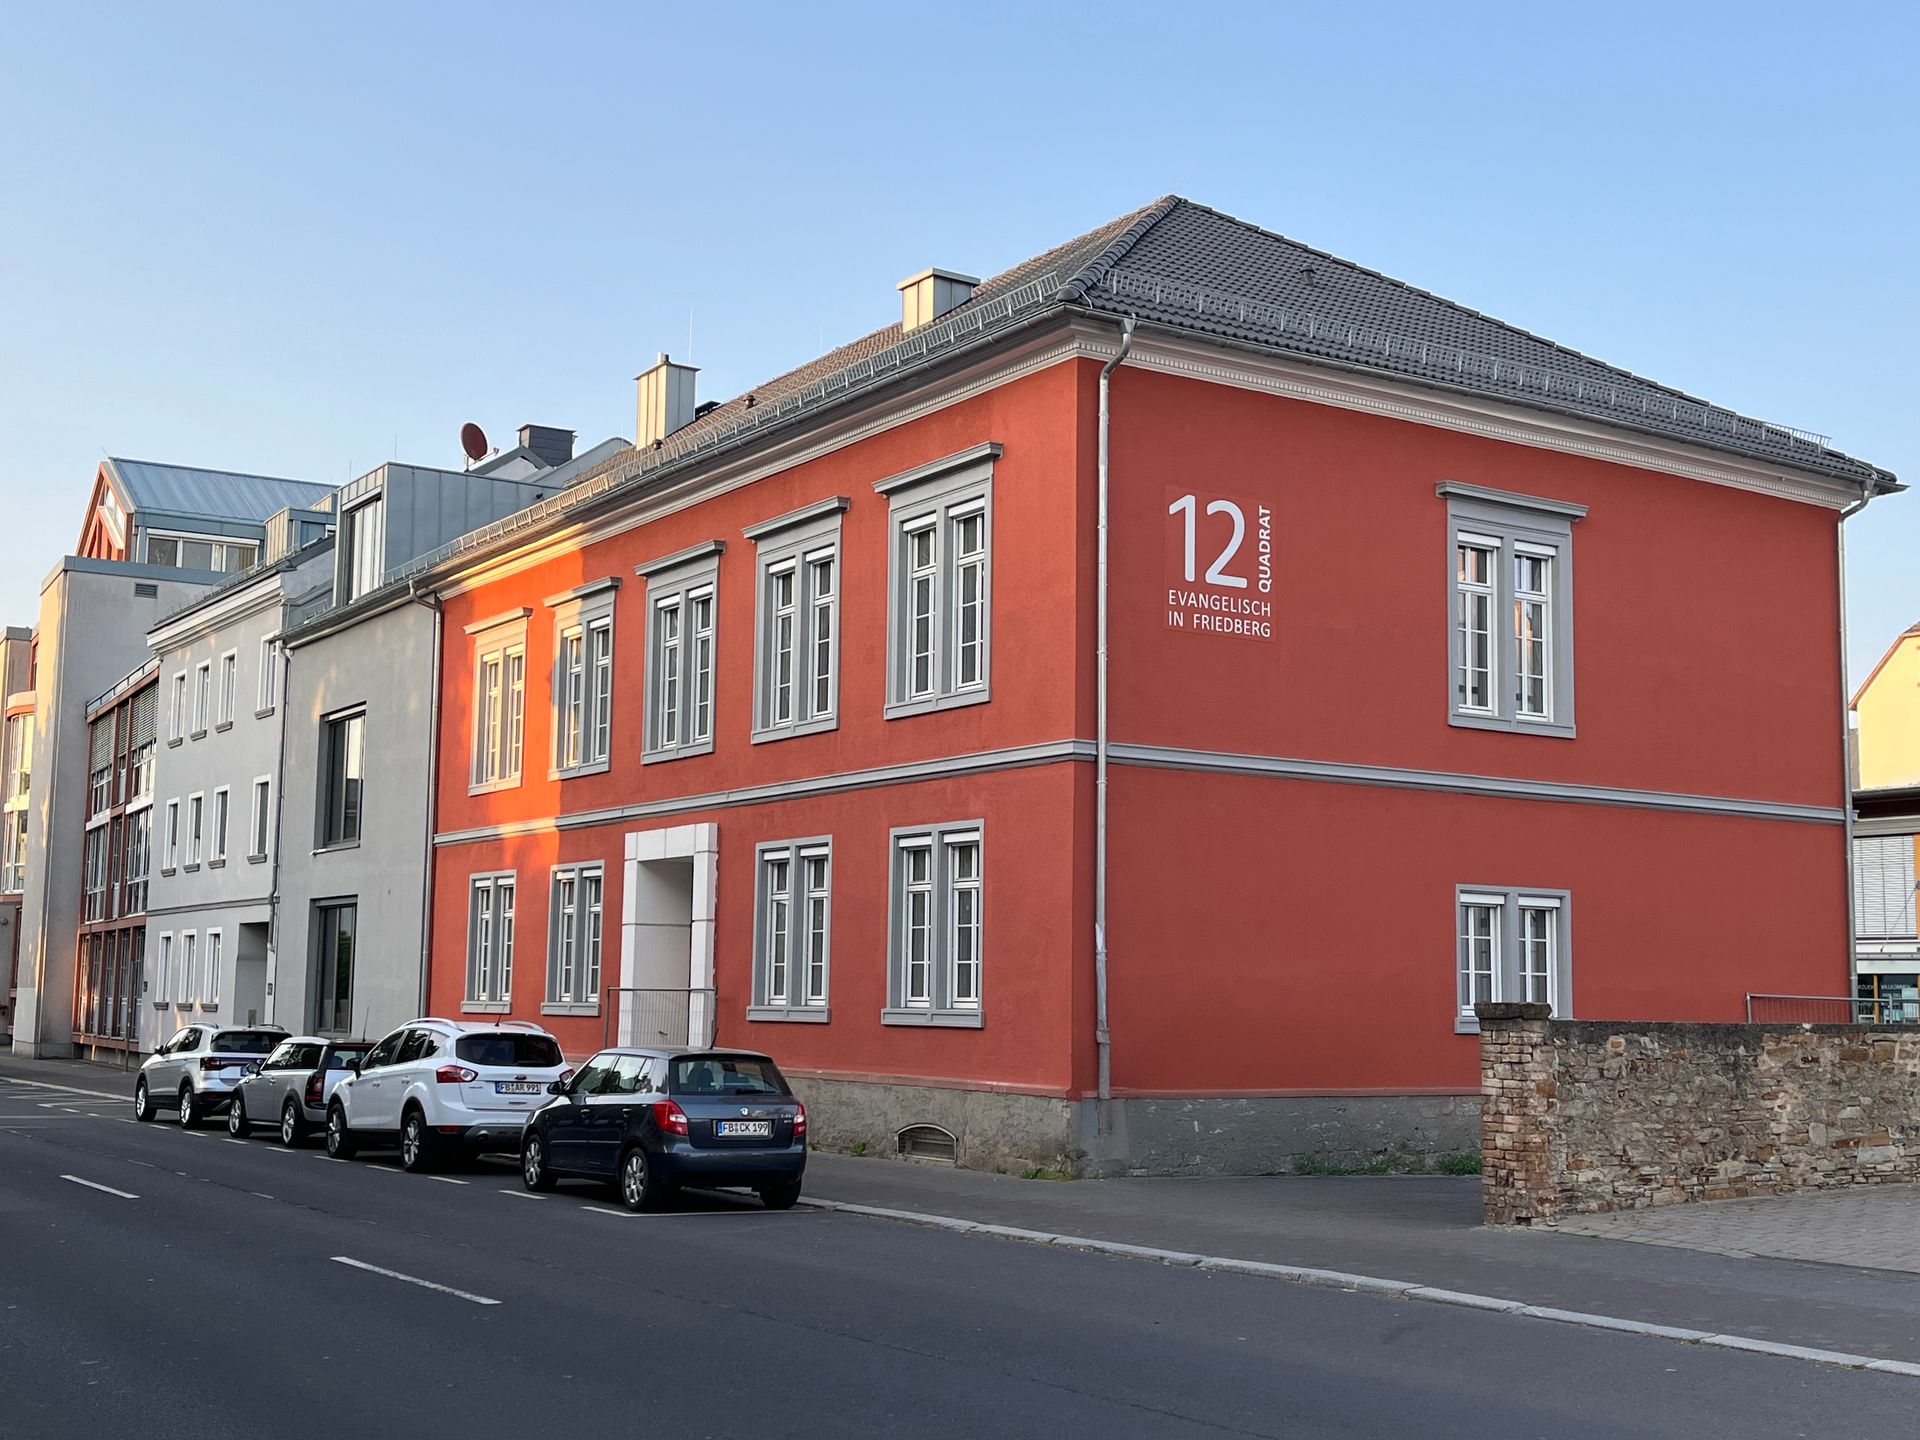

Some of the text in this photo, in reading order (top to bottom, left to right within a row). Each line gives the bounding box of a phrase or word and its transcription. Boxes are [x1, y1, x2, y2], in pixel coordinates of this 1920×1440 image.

[1168, 494, 1248, 589] 12
[1258, 504, 1272, 593] QUADRAT
[1168, 589, 1271, 617] EVANGELISCH
[1168, 610, 1271, 637] IN FRIEDBERG
[500, 1083, 511, 1091] FB
[526, 1084, 540, 1092] 991
[722, 1123, 768, 1132] FB CK 199
